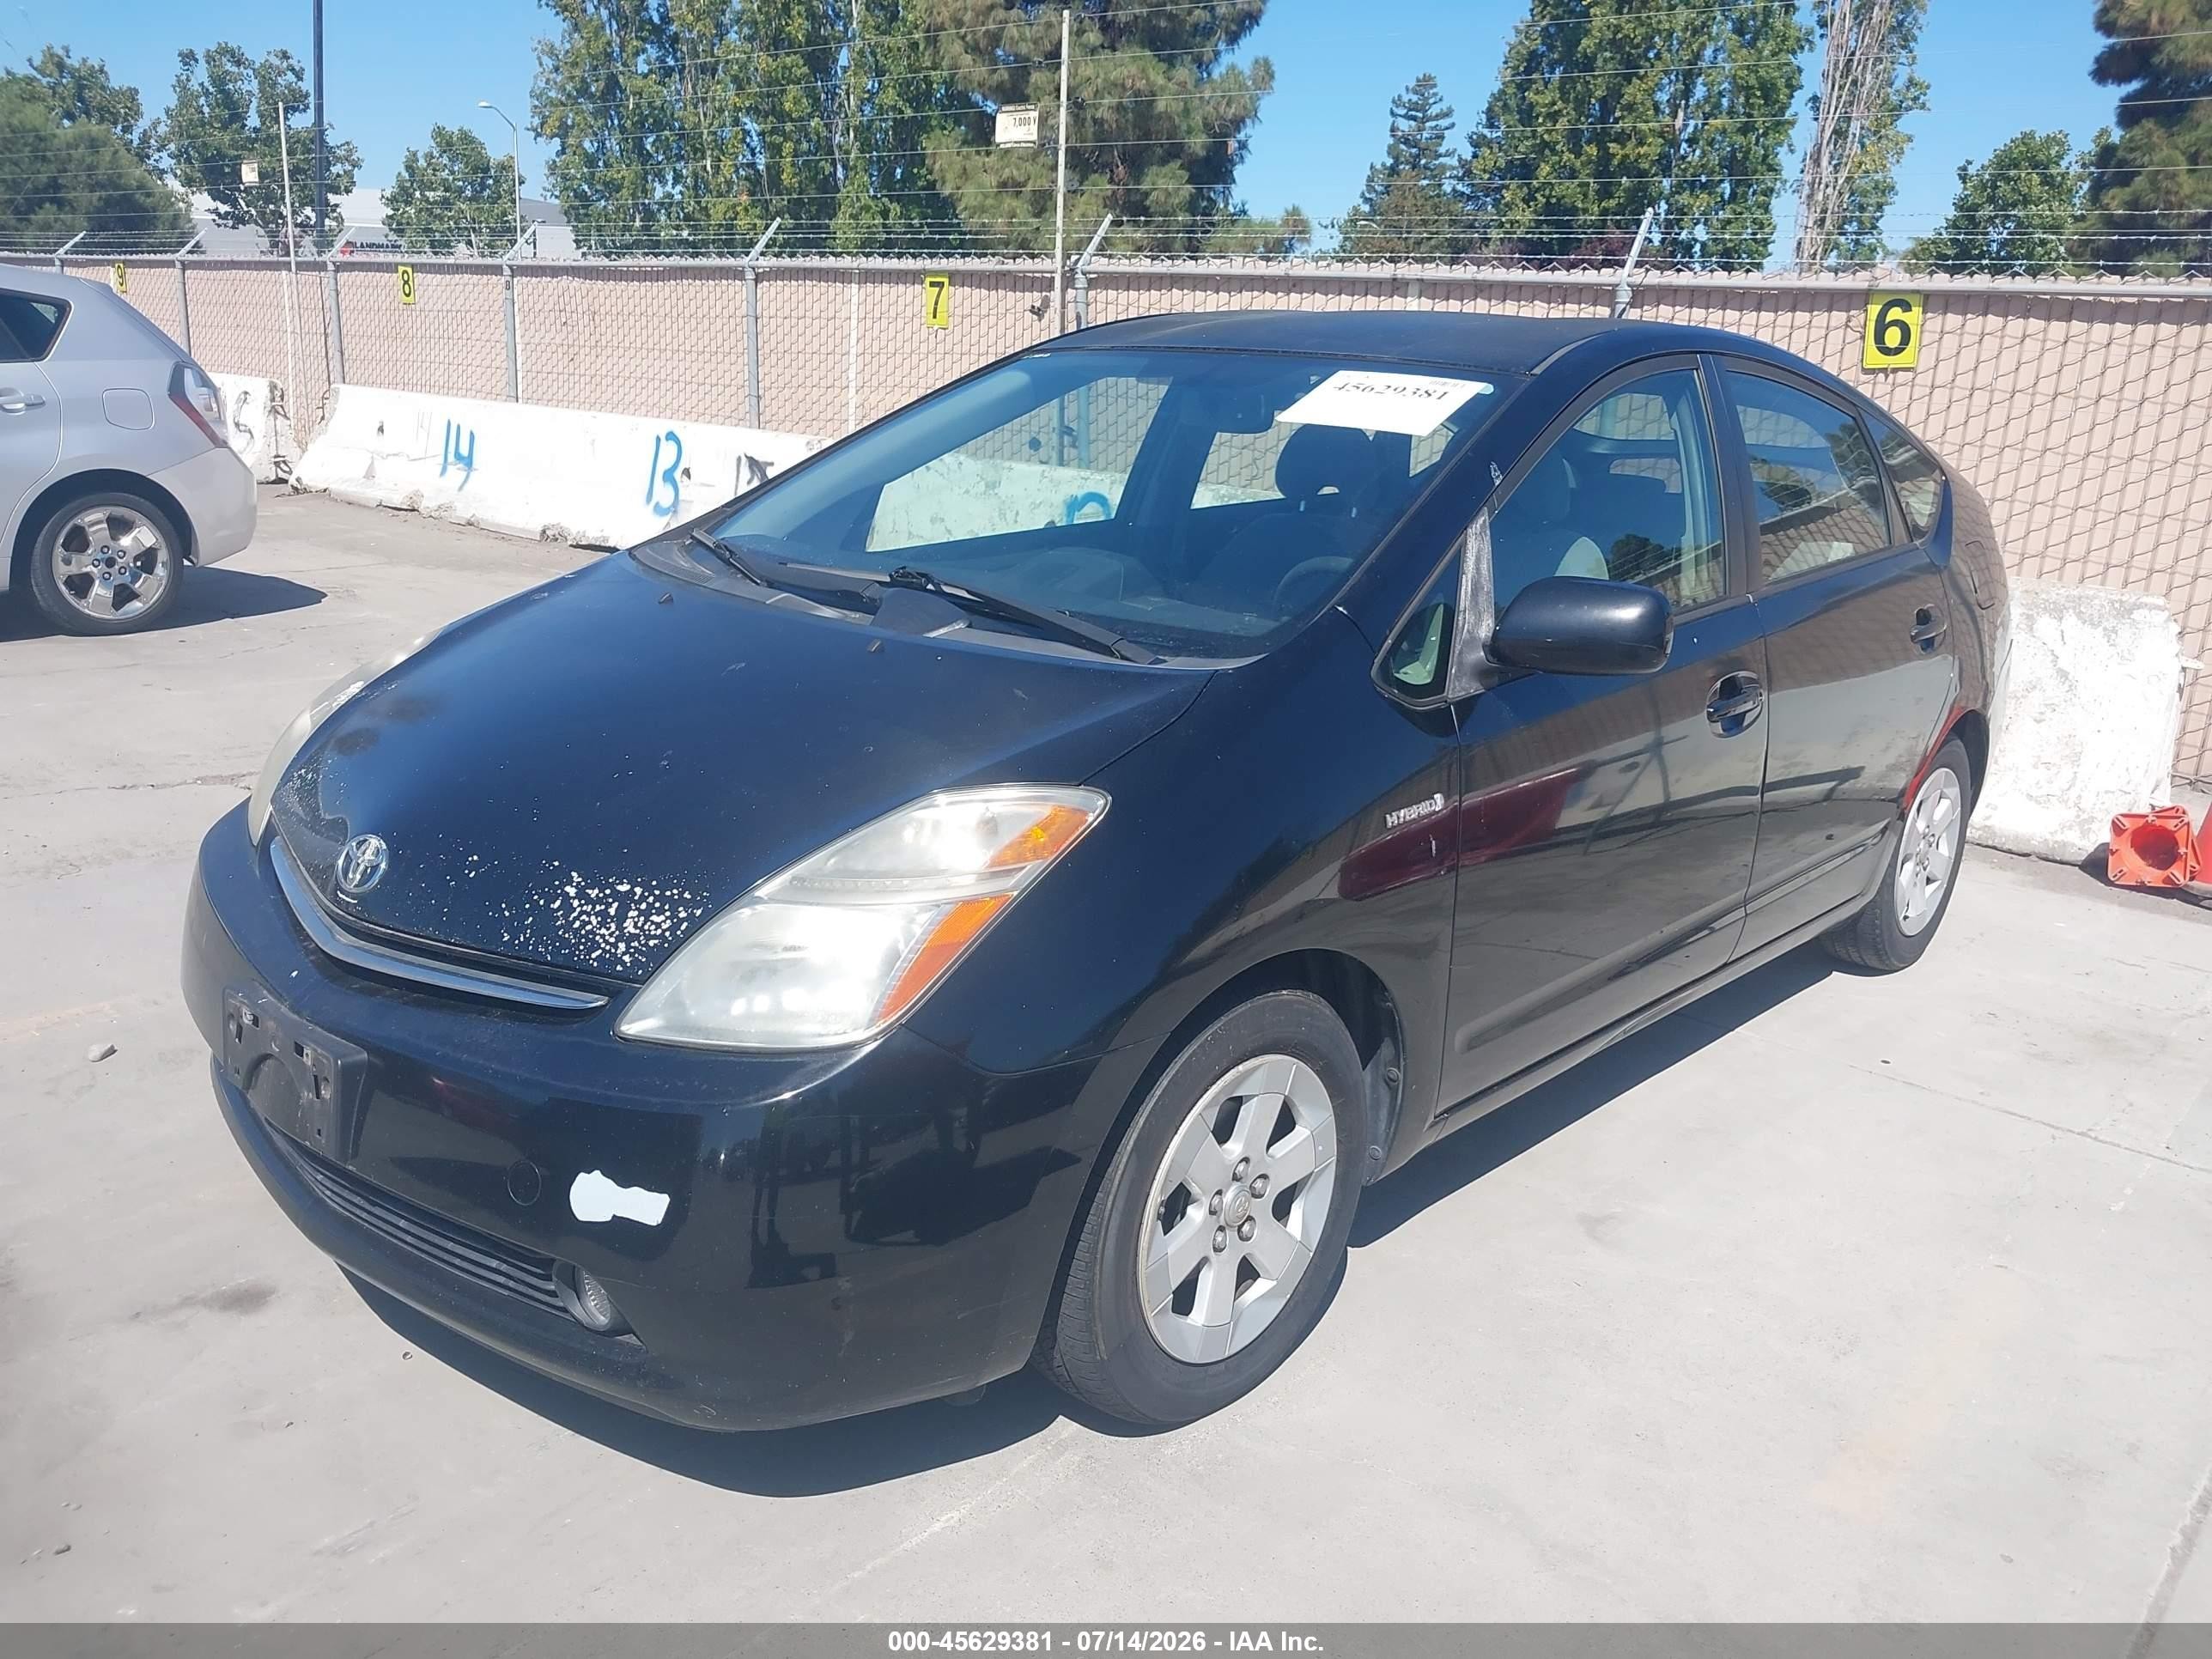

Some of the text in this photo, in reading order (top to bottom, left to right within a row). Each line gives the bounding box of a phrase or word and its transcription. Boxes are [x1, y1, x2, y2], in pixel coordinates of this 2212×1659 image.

[117, 264, 124, 287] 9
[401, 270, 412, 298] 8
[929, 281, 945, 319] 7
[1874, 298, 1912, 356] 6
[439, 418, 475, 492] 14
[646, 430, 683, 517] 13
[1385, 799, 1437, 829] HYBRID
